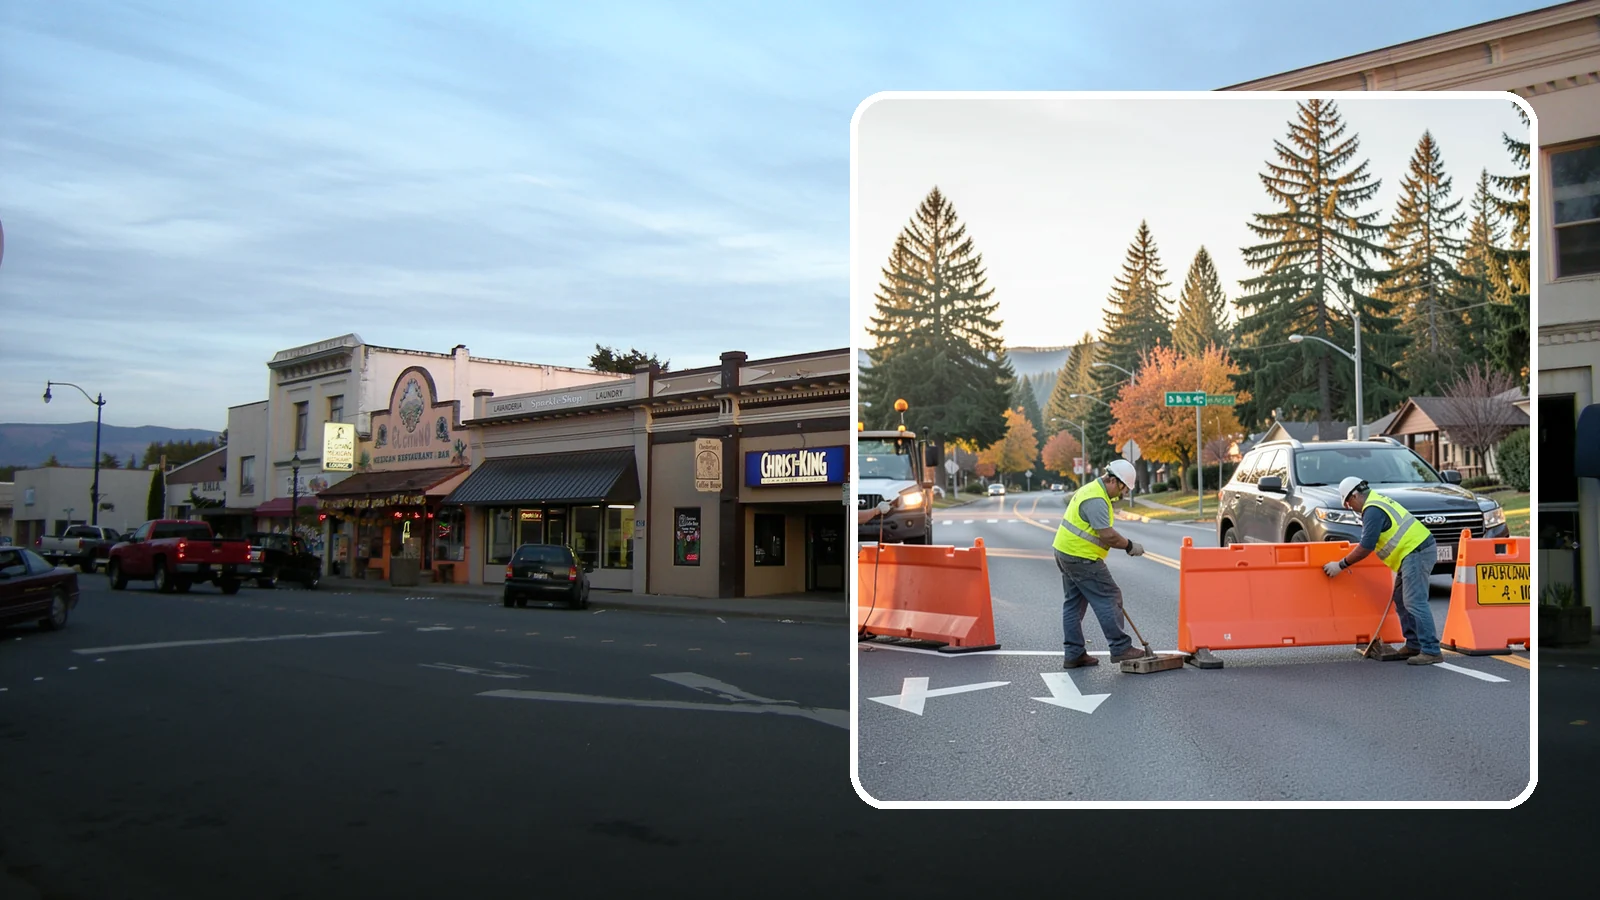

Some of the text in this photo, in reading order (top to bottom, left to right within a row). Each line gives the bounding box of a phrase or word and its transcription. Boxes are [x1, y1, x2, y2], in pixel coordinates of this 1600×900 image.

[595, 389, 623, 399] LAUNDRY
[494, 402, 522, 412] LAVANDERIA
[531, 394, 582, 409] Sparkle Shop
[373, 450, 450, 464] MEXICAN RESTAURANT BAR
[760, 450, 827, 478] CHRIST KING
